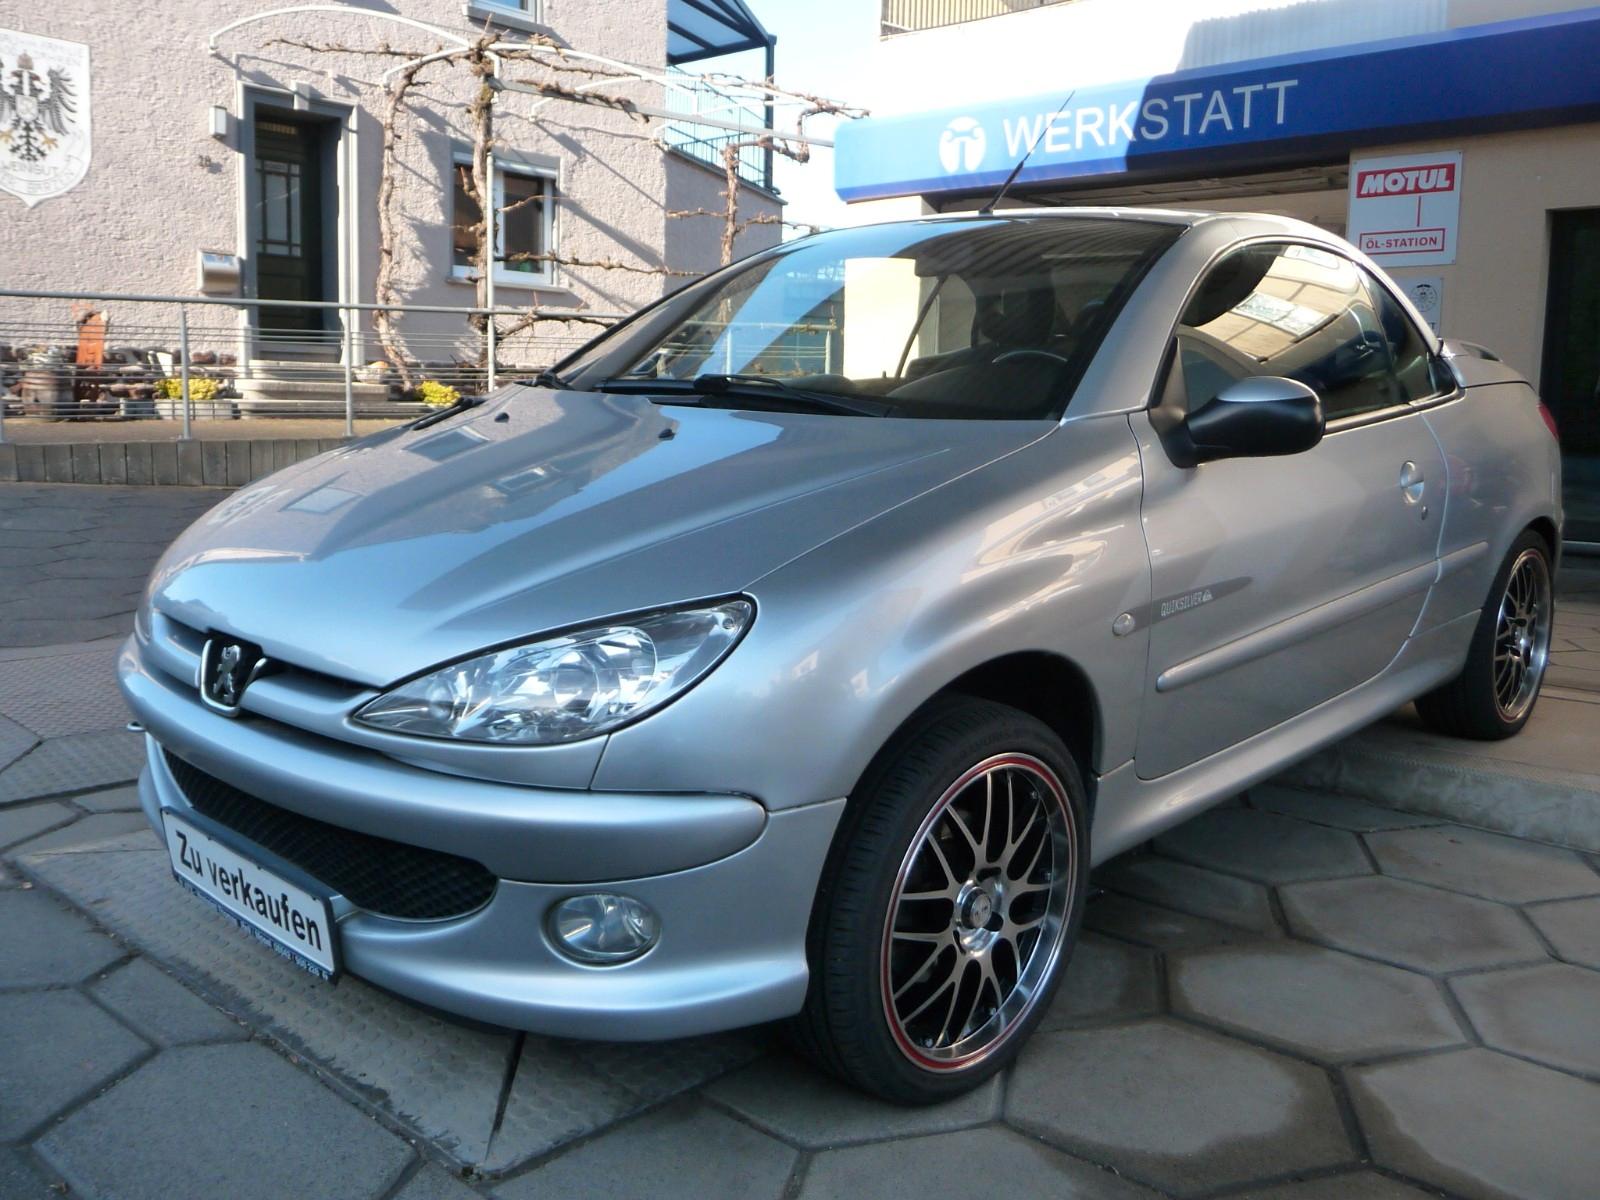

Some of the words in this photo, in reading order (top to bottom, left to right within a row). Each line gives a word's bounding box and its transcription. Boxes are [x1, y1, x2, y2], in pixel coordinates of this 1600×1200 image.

[1003, 79, 1298, 157] WERKSTATT
[1360, 167, 1450, 195] MOTUL
[1366, 235, 1438, 249] ÖL-STATION
[176, 830, 203, 877] Zu
[206, 857, 322, 951] verkaufen
